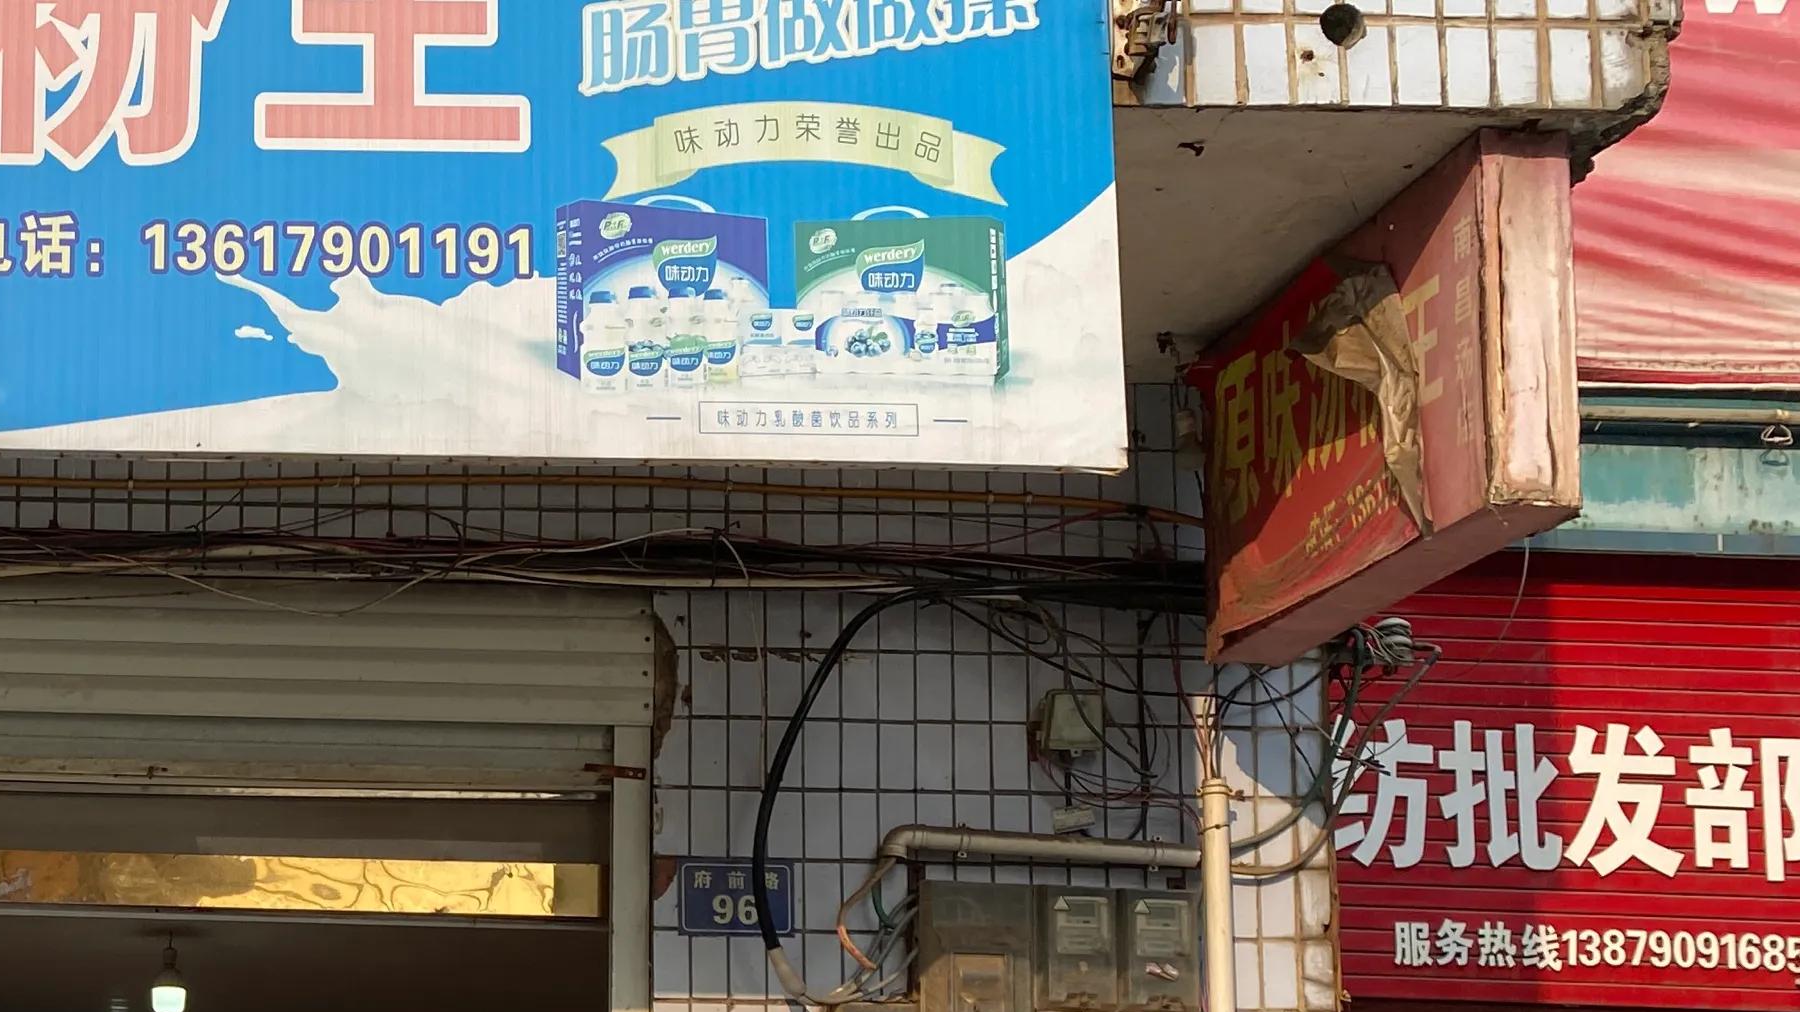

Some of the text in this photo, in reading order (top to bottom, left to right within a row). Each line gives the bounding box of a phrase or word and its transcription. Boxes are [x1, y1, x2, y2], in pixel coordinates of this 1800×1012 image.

[674, 113, 942, 163] 味动力荣誉出品
[661, 239, 711, 256] werdery
[863, 245, 917, 264] werdery
[664, 264, 710, 283] 味动力
[868, 271, 915, 289] 味动力
[717, 409, 898, 429] 味动力乳酸菌饮品系列
[712, 894, 759, 926] 96
